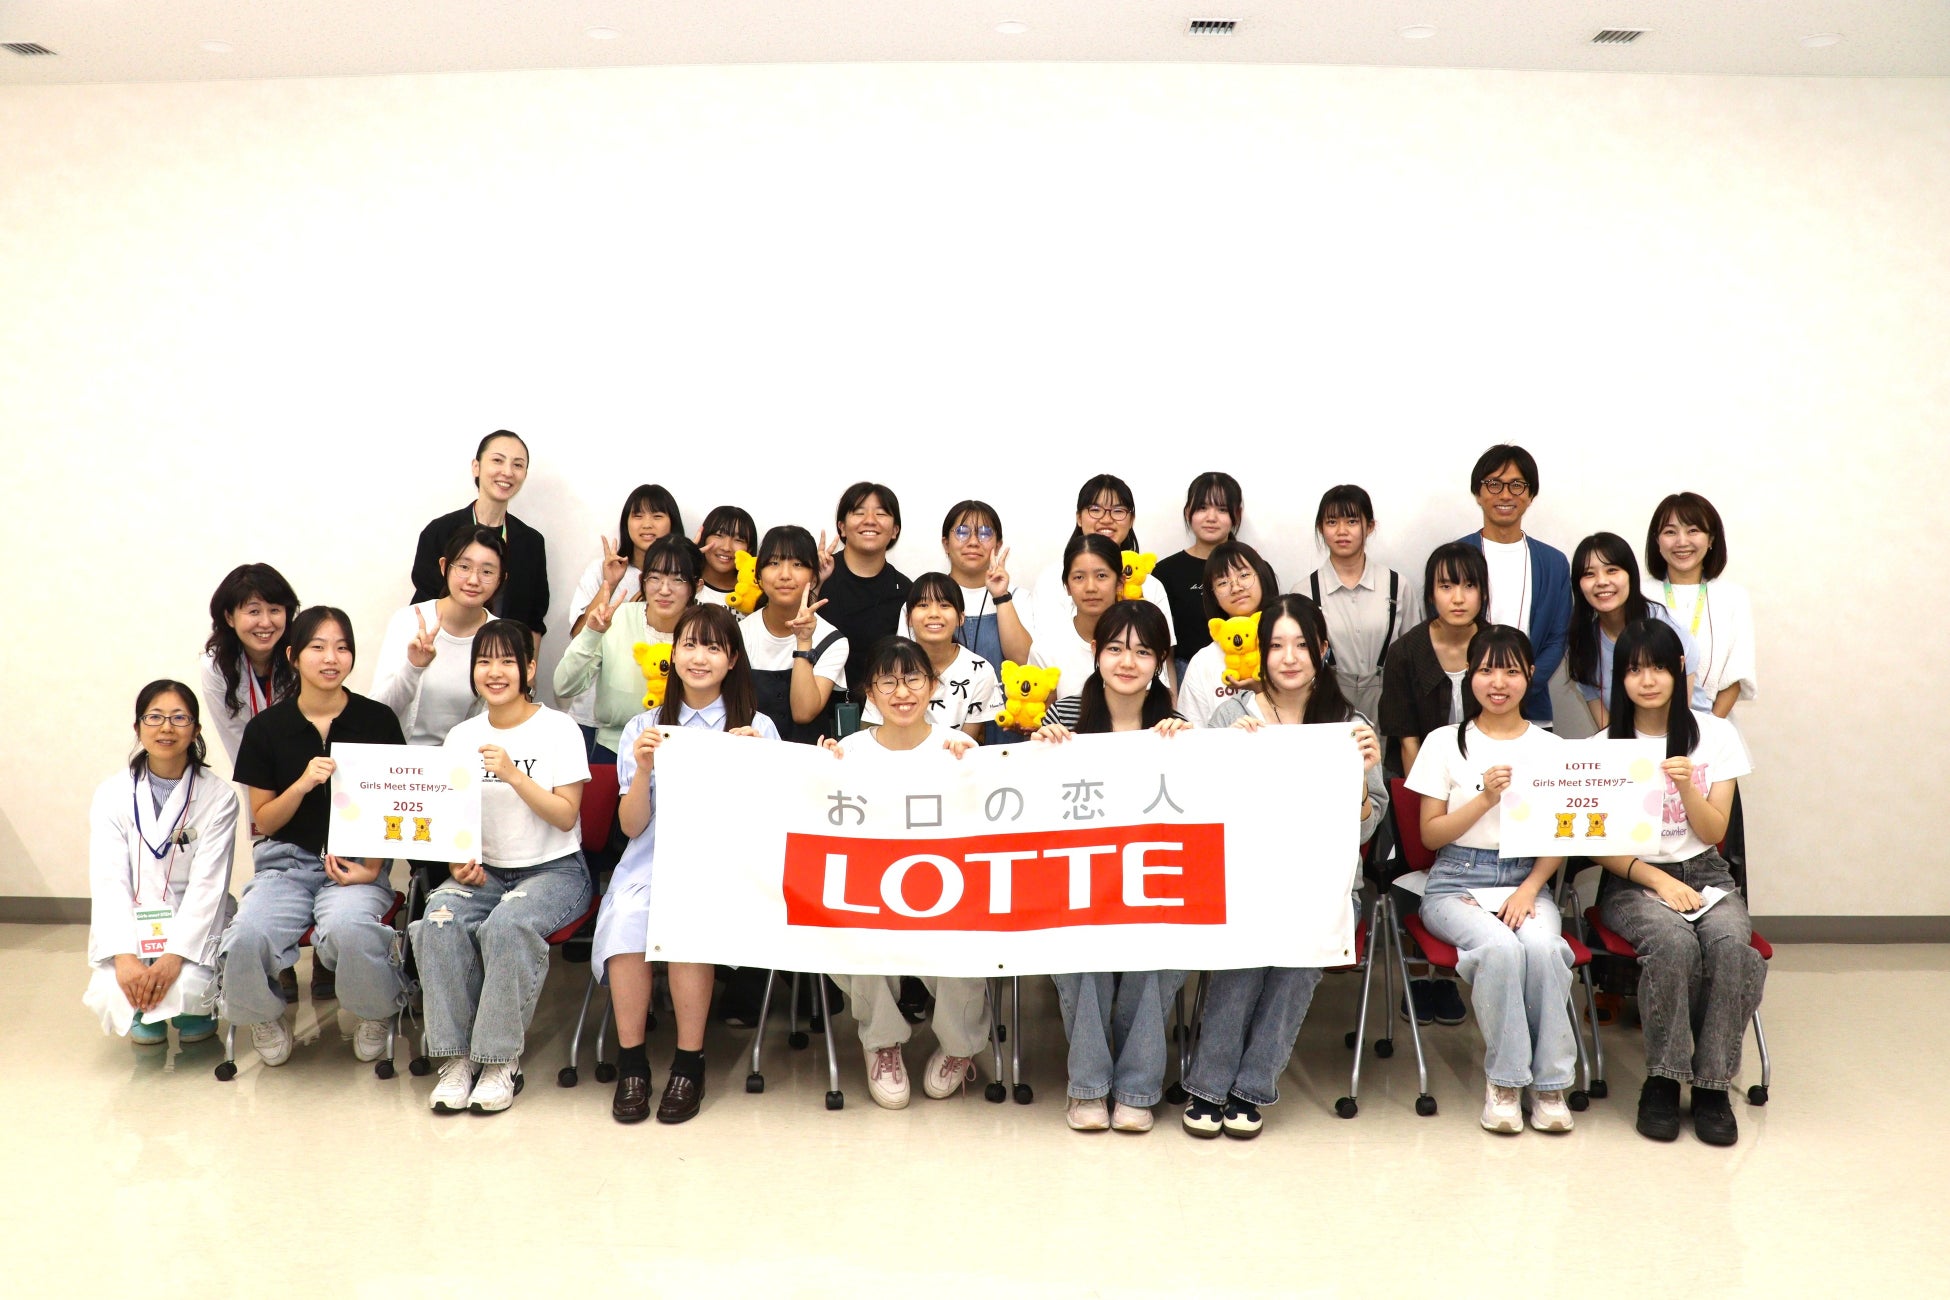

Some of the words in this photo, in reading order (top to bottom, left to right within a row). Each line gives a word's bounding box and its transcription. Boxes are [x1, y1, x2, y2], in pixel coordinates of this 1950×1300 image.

[389, 766, 424, 775] LOTTE
[1565, 762, 1602, 770] LOTTE
[359, 781, 382, 790] Girls
[384, 782, 407, 791] Meet
[409, 783, 455, 793] STEMツアー
[1532, 778, 1556, 788] Girls
[1558, 779, 1582, 787] Meet
[1585, 777, 1634, 787] STEMツアー
[393, 801, 424, 812] 2025
[827, 773, 1184, 829] お口の恋人
[1565, 797, 1600, 808] 2025
[822, 841, 1184, 917] LOTTE
